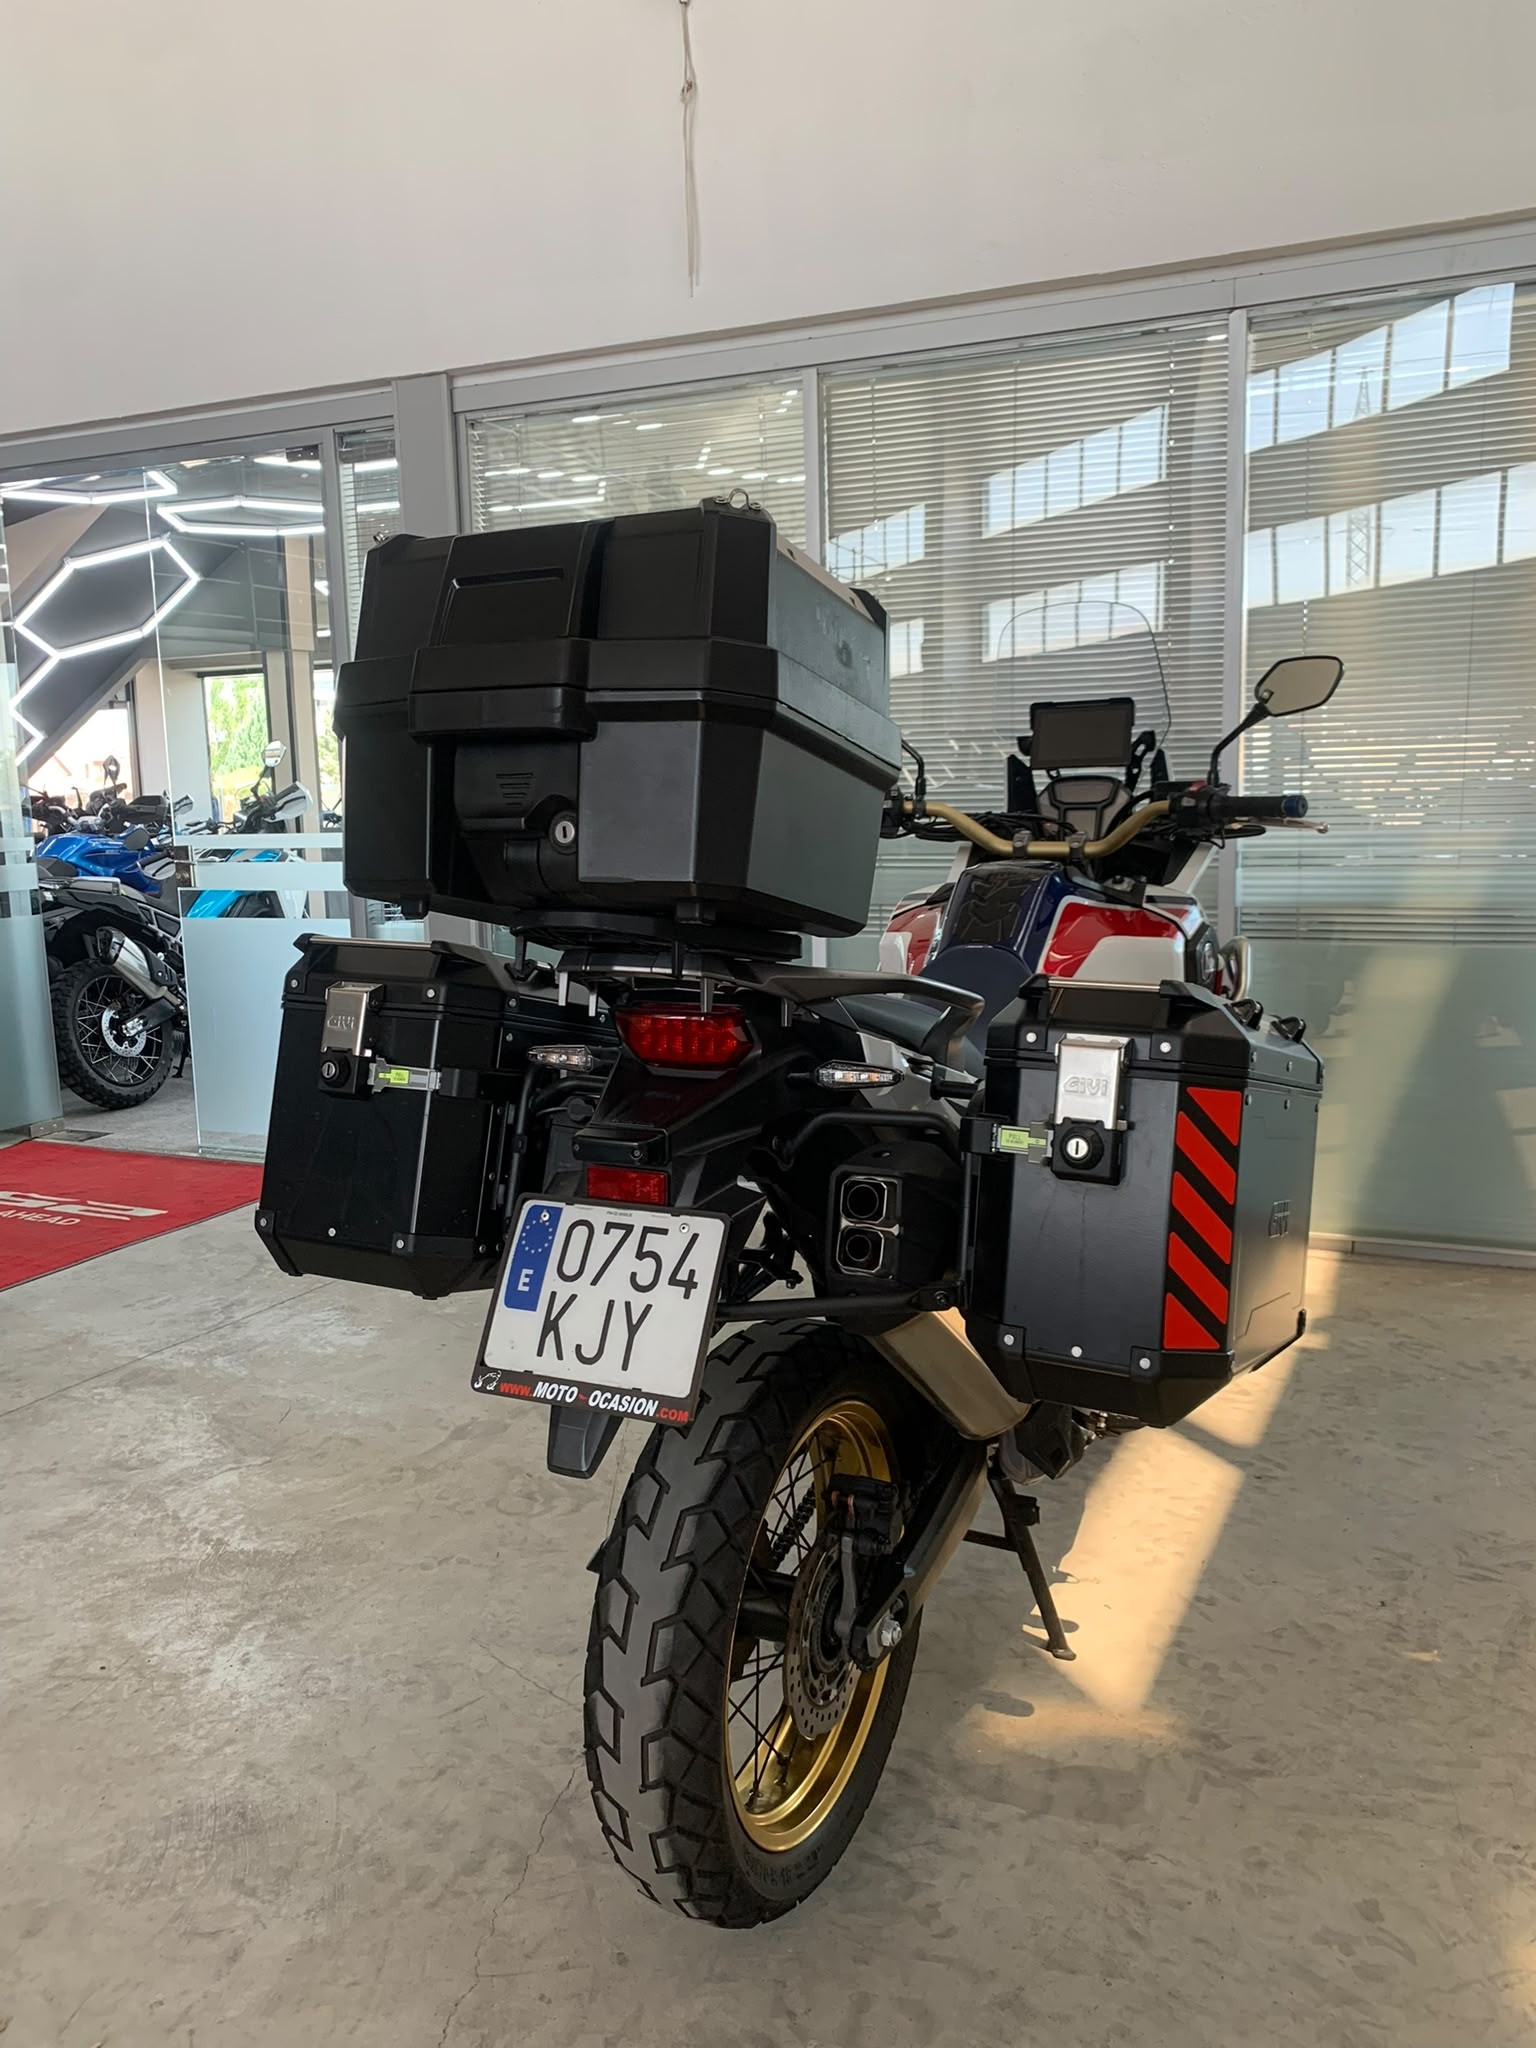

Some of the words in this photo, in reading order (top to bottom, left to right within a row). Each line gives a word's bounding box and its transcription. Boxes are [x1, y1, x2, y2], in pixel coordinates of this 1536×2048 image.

[1063, 1075, 1108, 1096] GIVI
[0, 1209, 81, 1226] AHEAD
[556, 1219, 700, 1300] 0754
[517, 1268, 534, 1292] E
[536, 1290, 653, 1372] KJY
